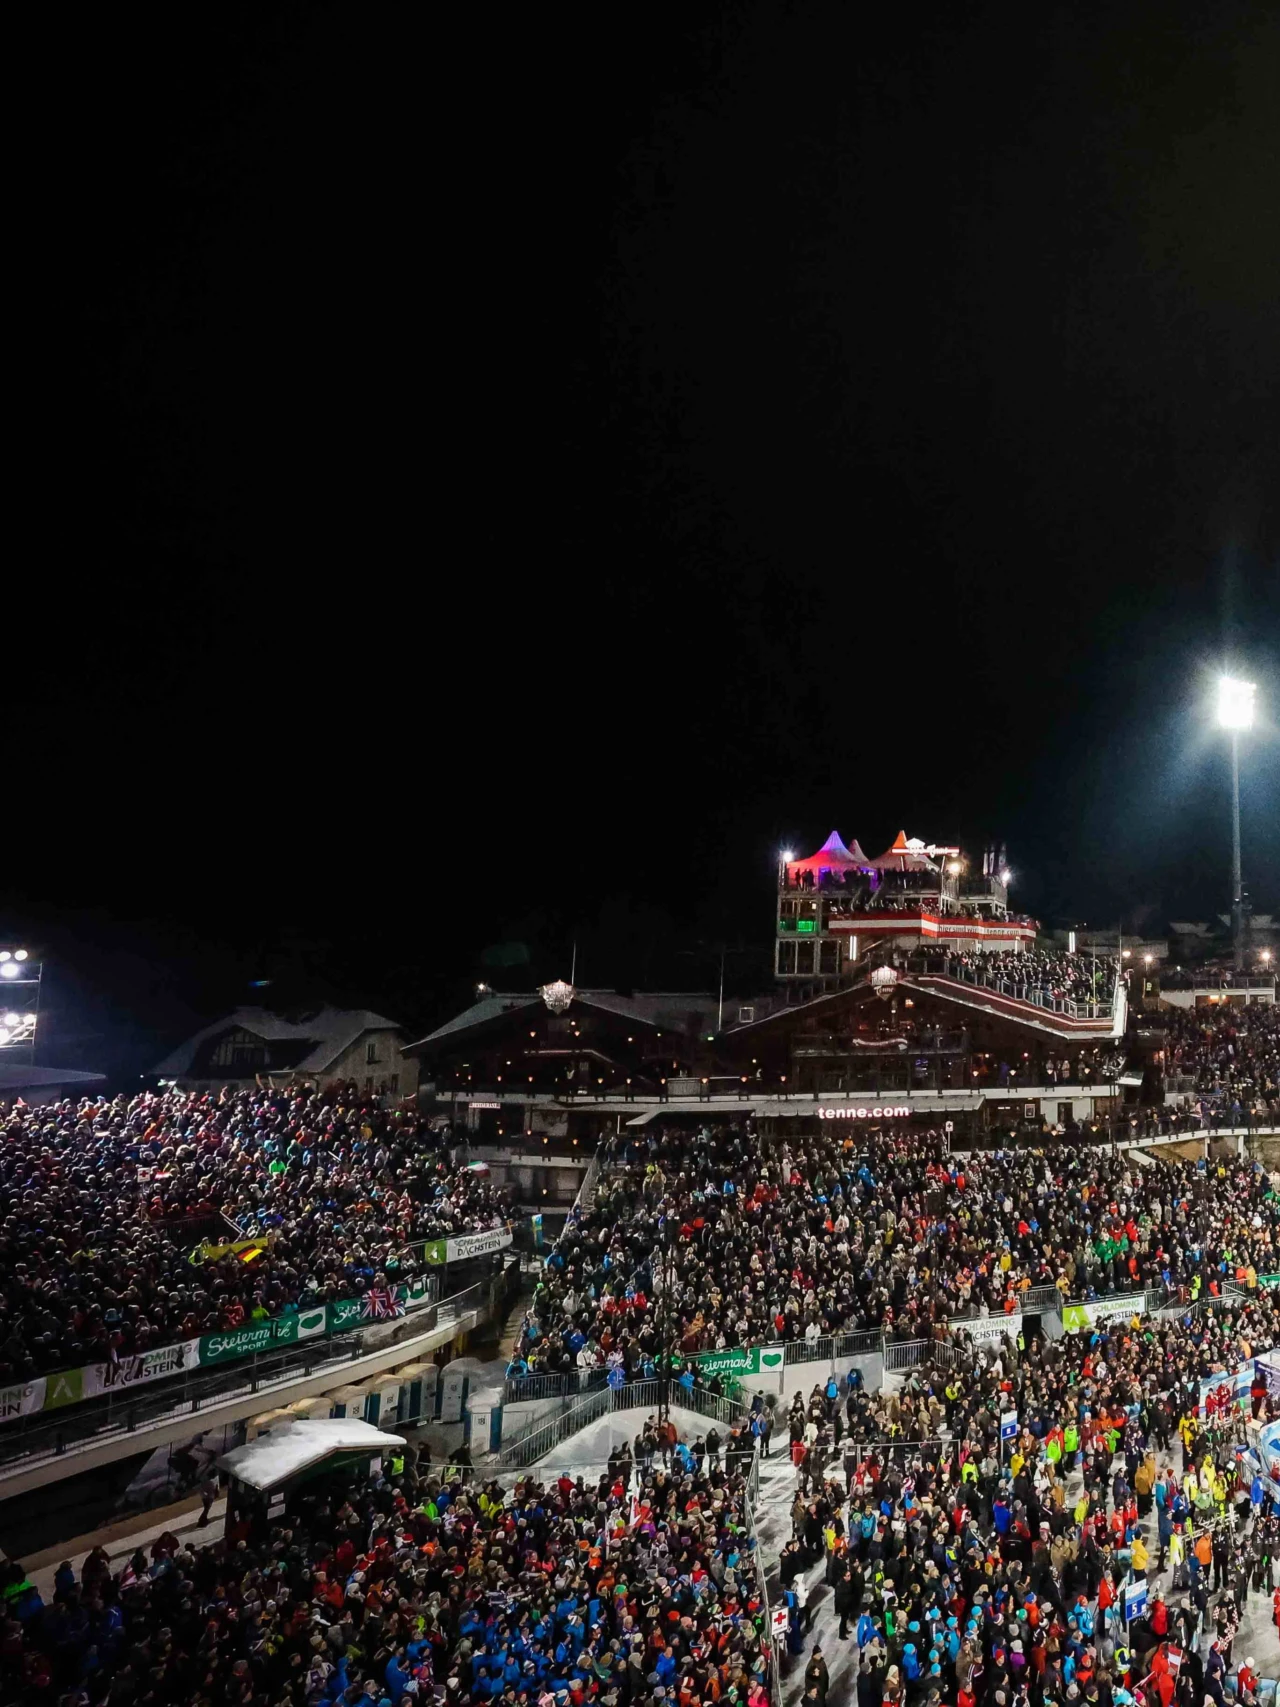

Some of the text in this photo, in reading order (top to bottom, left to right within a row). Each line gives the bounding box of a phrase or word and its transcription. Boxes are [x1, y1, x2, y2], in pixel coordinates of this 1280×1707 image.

[818, 1106, 909, 1119] tenne.com
[237, 1340, 267, 1352] SPORT
[1132, 1603, 1138, 1615] 5
